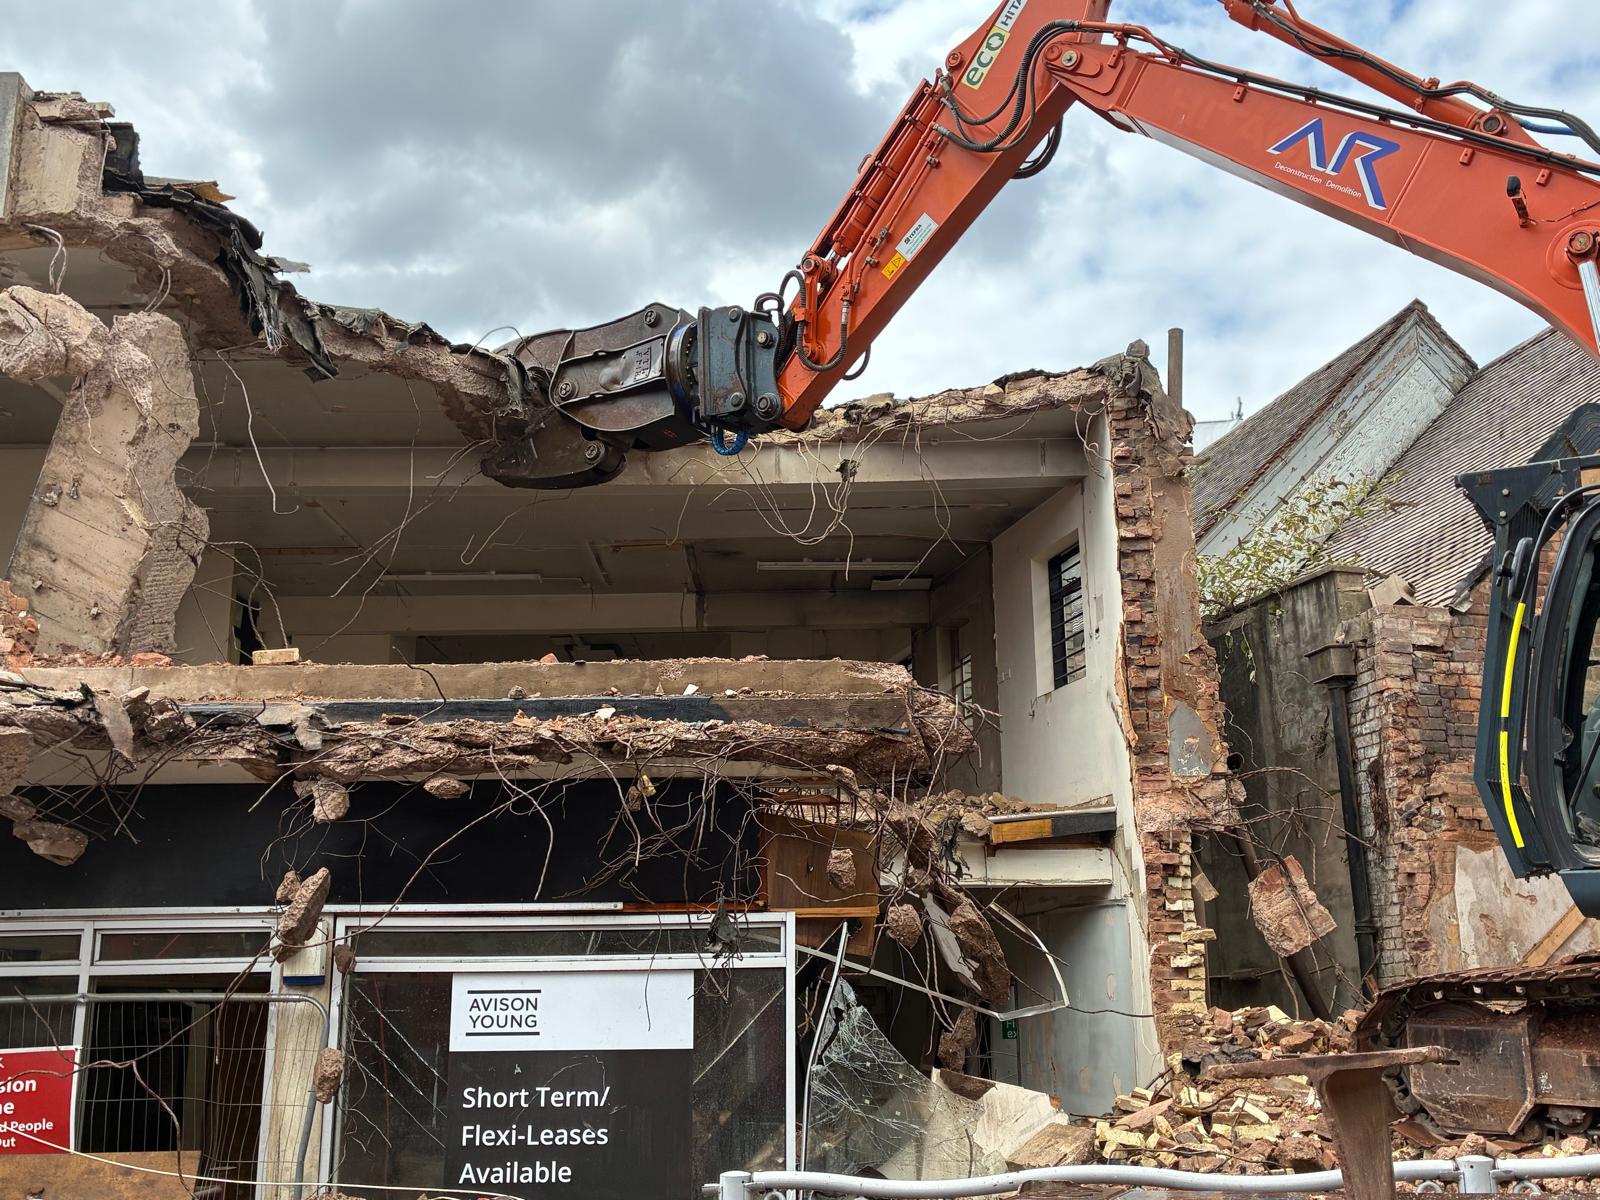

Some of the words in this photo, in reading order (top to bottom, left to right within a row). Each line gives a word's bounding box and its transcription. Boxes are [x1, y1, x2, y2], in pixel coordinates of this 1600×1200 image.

[1266, 117, 1400, 210] AR
[1274, 161, 1322, 184] Deconstruction
[1325, 180, 1362, 198] Demolition
[469, 997, 538, 1012] AVISON
[469, 1014, 537, 1029] YOUNG
[462, 1087, 530, 1108] Short
[535, 1086, 611, 1108] Term/
[10, 1118, 54, 1134] People
[461, 1124, 609, 1147] Flexi-Leases
[458, 1161, 572, 1185] Available
